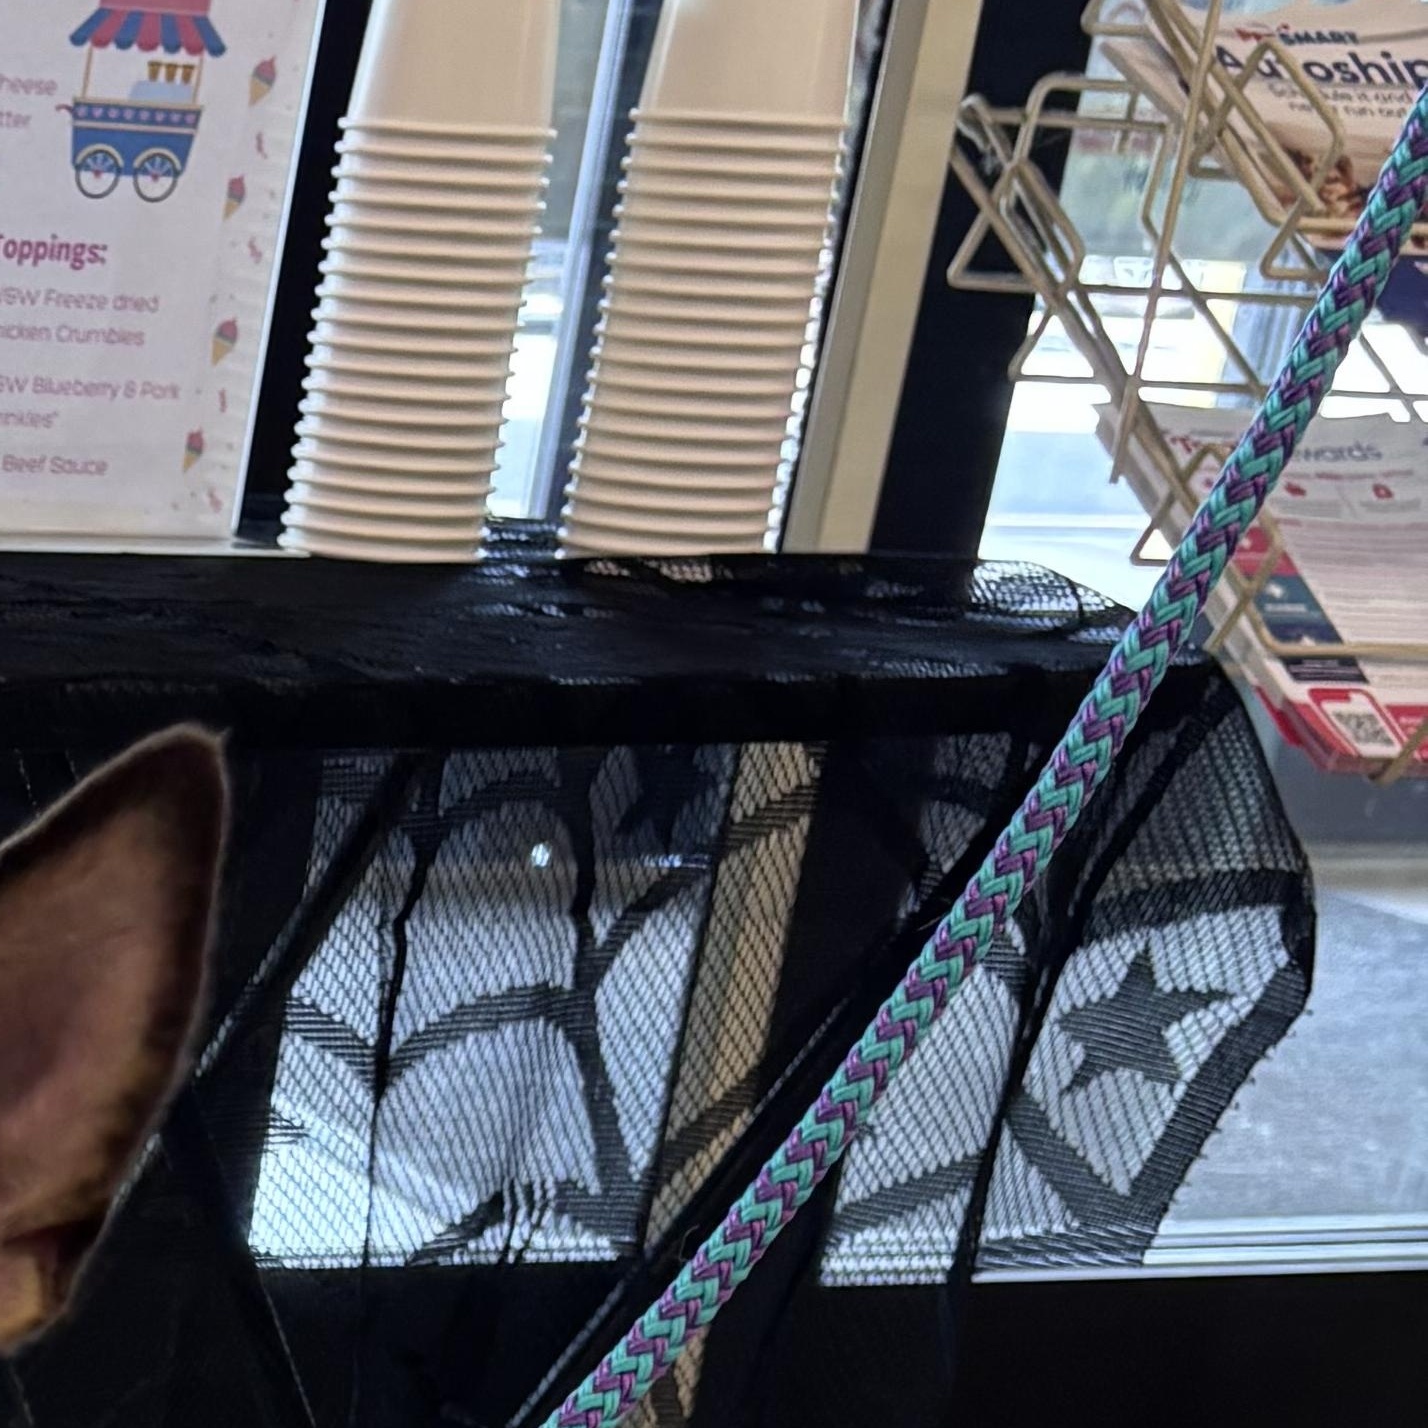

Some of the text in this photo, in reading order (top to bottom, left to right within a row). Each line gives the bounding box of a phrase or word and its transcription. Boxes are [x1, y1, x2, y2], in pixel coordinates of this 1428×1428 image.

[44, 288, 108, 310] Freeze
[55, 324, 145, 347] Crumbles
[32, 375, 121, 401] Blueberry
[49, 455, 108, 476] Sauce
